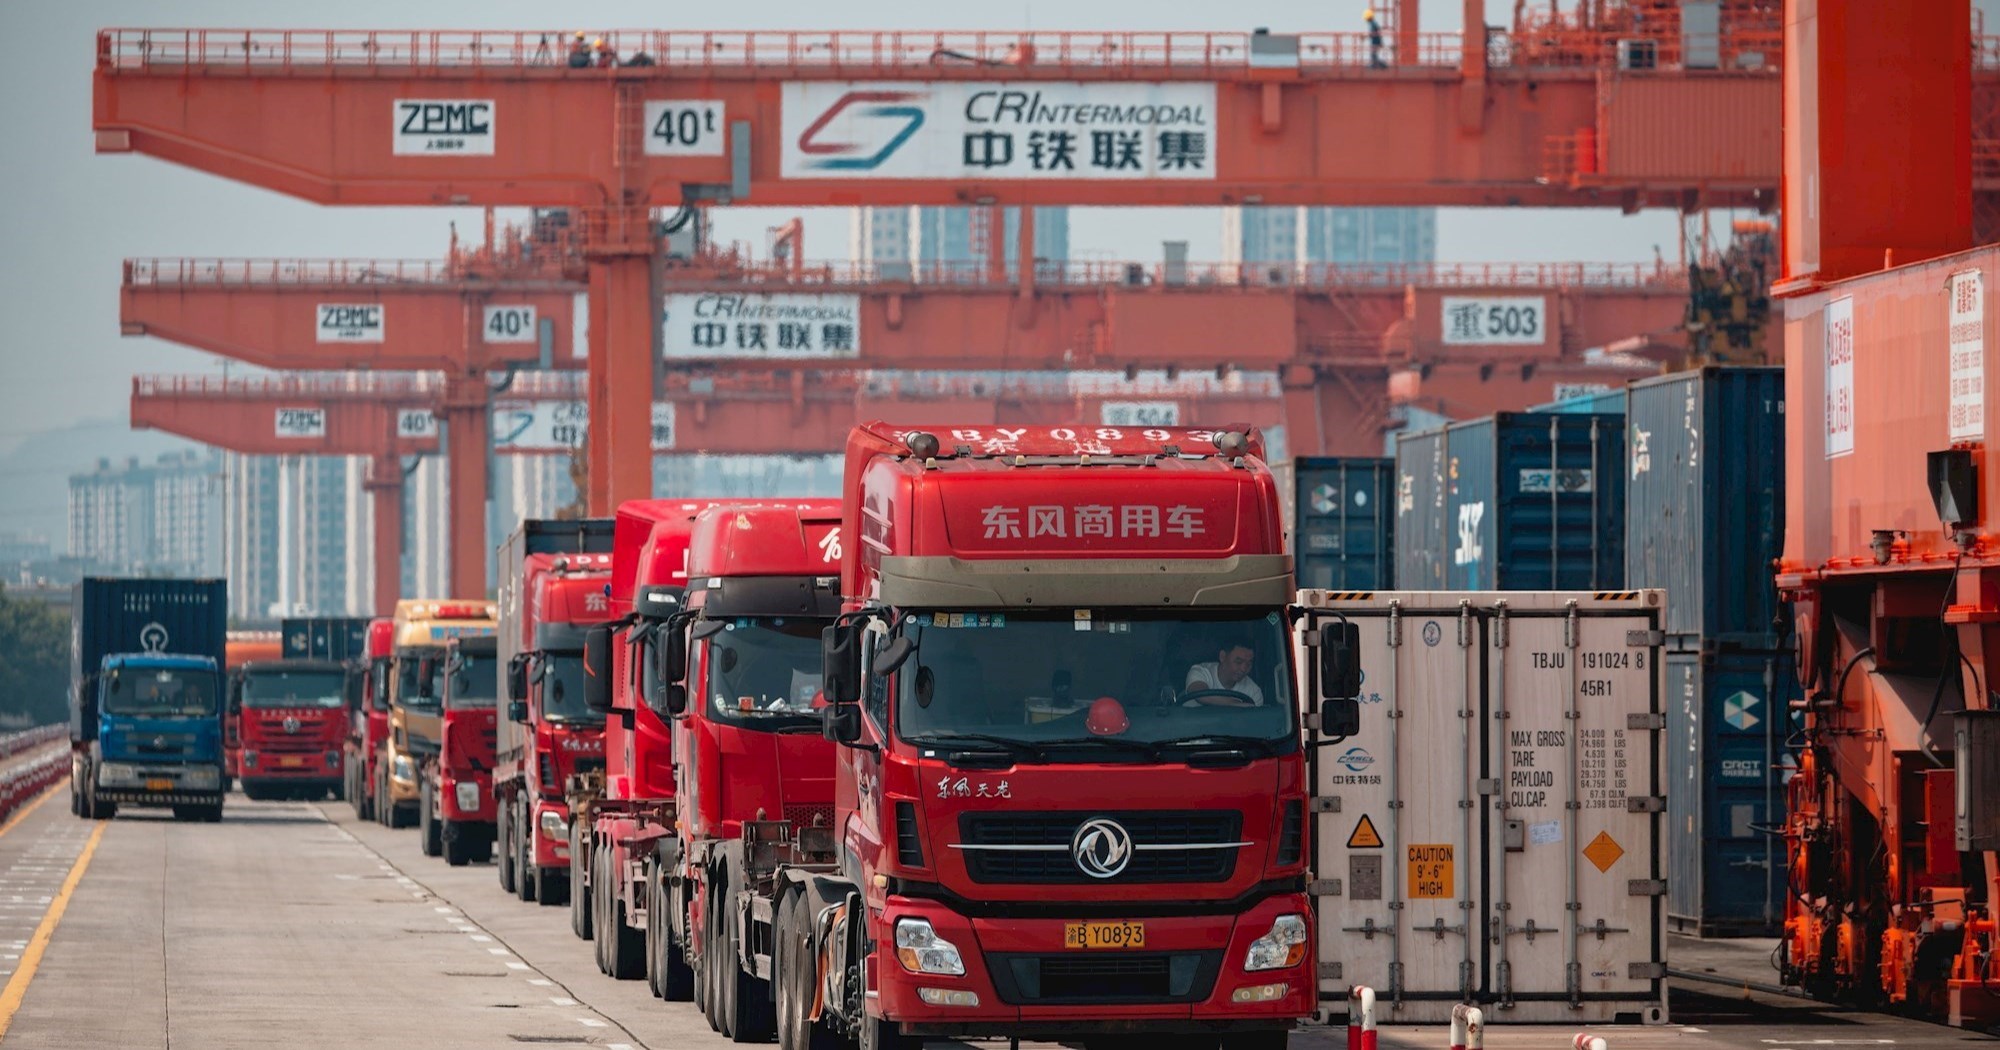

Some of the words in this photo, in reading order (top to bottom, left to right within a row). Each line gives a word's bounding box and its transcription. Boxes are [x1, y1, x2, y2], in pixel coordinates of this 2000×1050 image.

[401, 104, 489, 134] ZPMC
[653, 108, 715, 146] 40t
[964, 130, 1206, 170] 中铁联集
[321, 306, 379, 328] ZPMC
[489, 310, 530, 335] 40t
[692, 322, 853, 350] 中铁联集
[981, 504, 1206, 539] 东风商用车
[1532, 652, 1565, 669] TBJU
[1581, 652, 1628, 669] 191024
[1635, 652, 1645, 669] 8
[1580, 680, 1612, 696] 45R1
[1511, 731, 1532, 747] MAX
[1537, 731, 1565, 747] GROSS
[1580, 729, 1606, 738] 34.000
[1614, 729, 1623, 738] KG
[1614, 739, 1626, 748] LBS
[1512, 751, 1535, 767] TARE
[1614, 750, 1624, 759] KG
[1614, 760, 1627, 769] LBS
[1511, 771, 1553, 787] PAYLOAD
[1615, 770, 1624, 779] KG
[1615, 779, 1627, 788] LBS
[1511, 791, 1547, 807] CU.CAP.
[1408, 847, 1453, 862] CAUTION
[1418, 881, 1443, 895] HIGH
